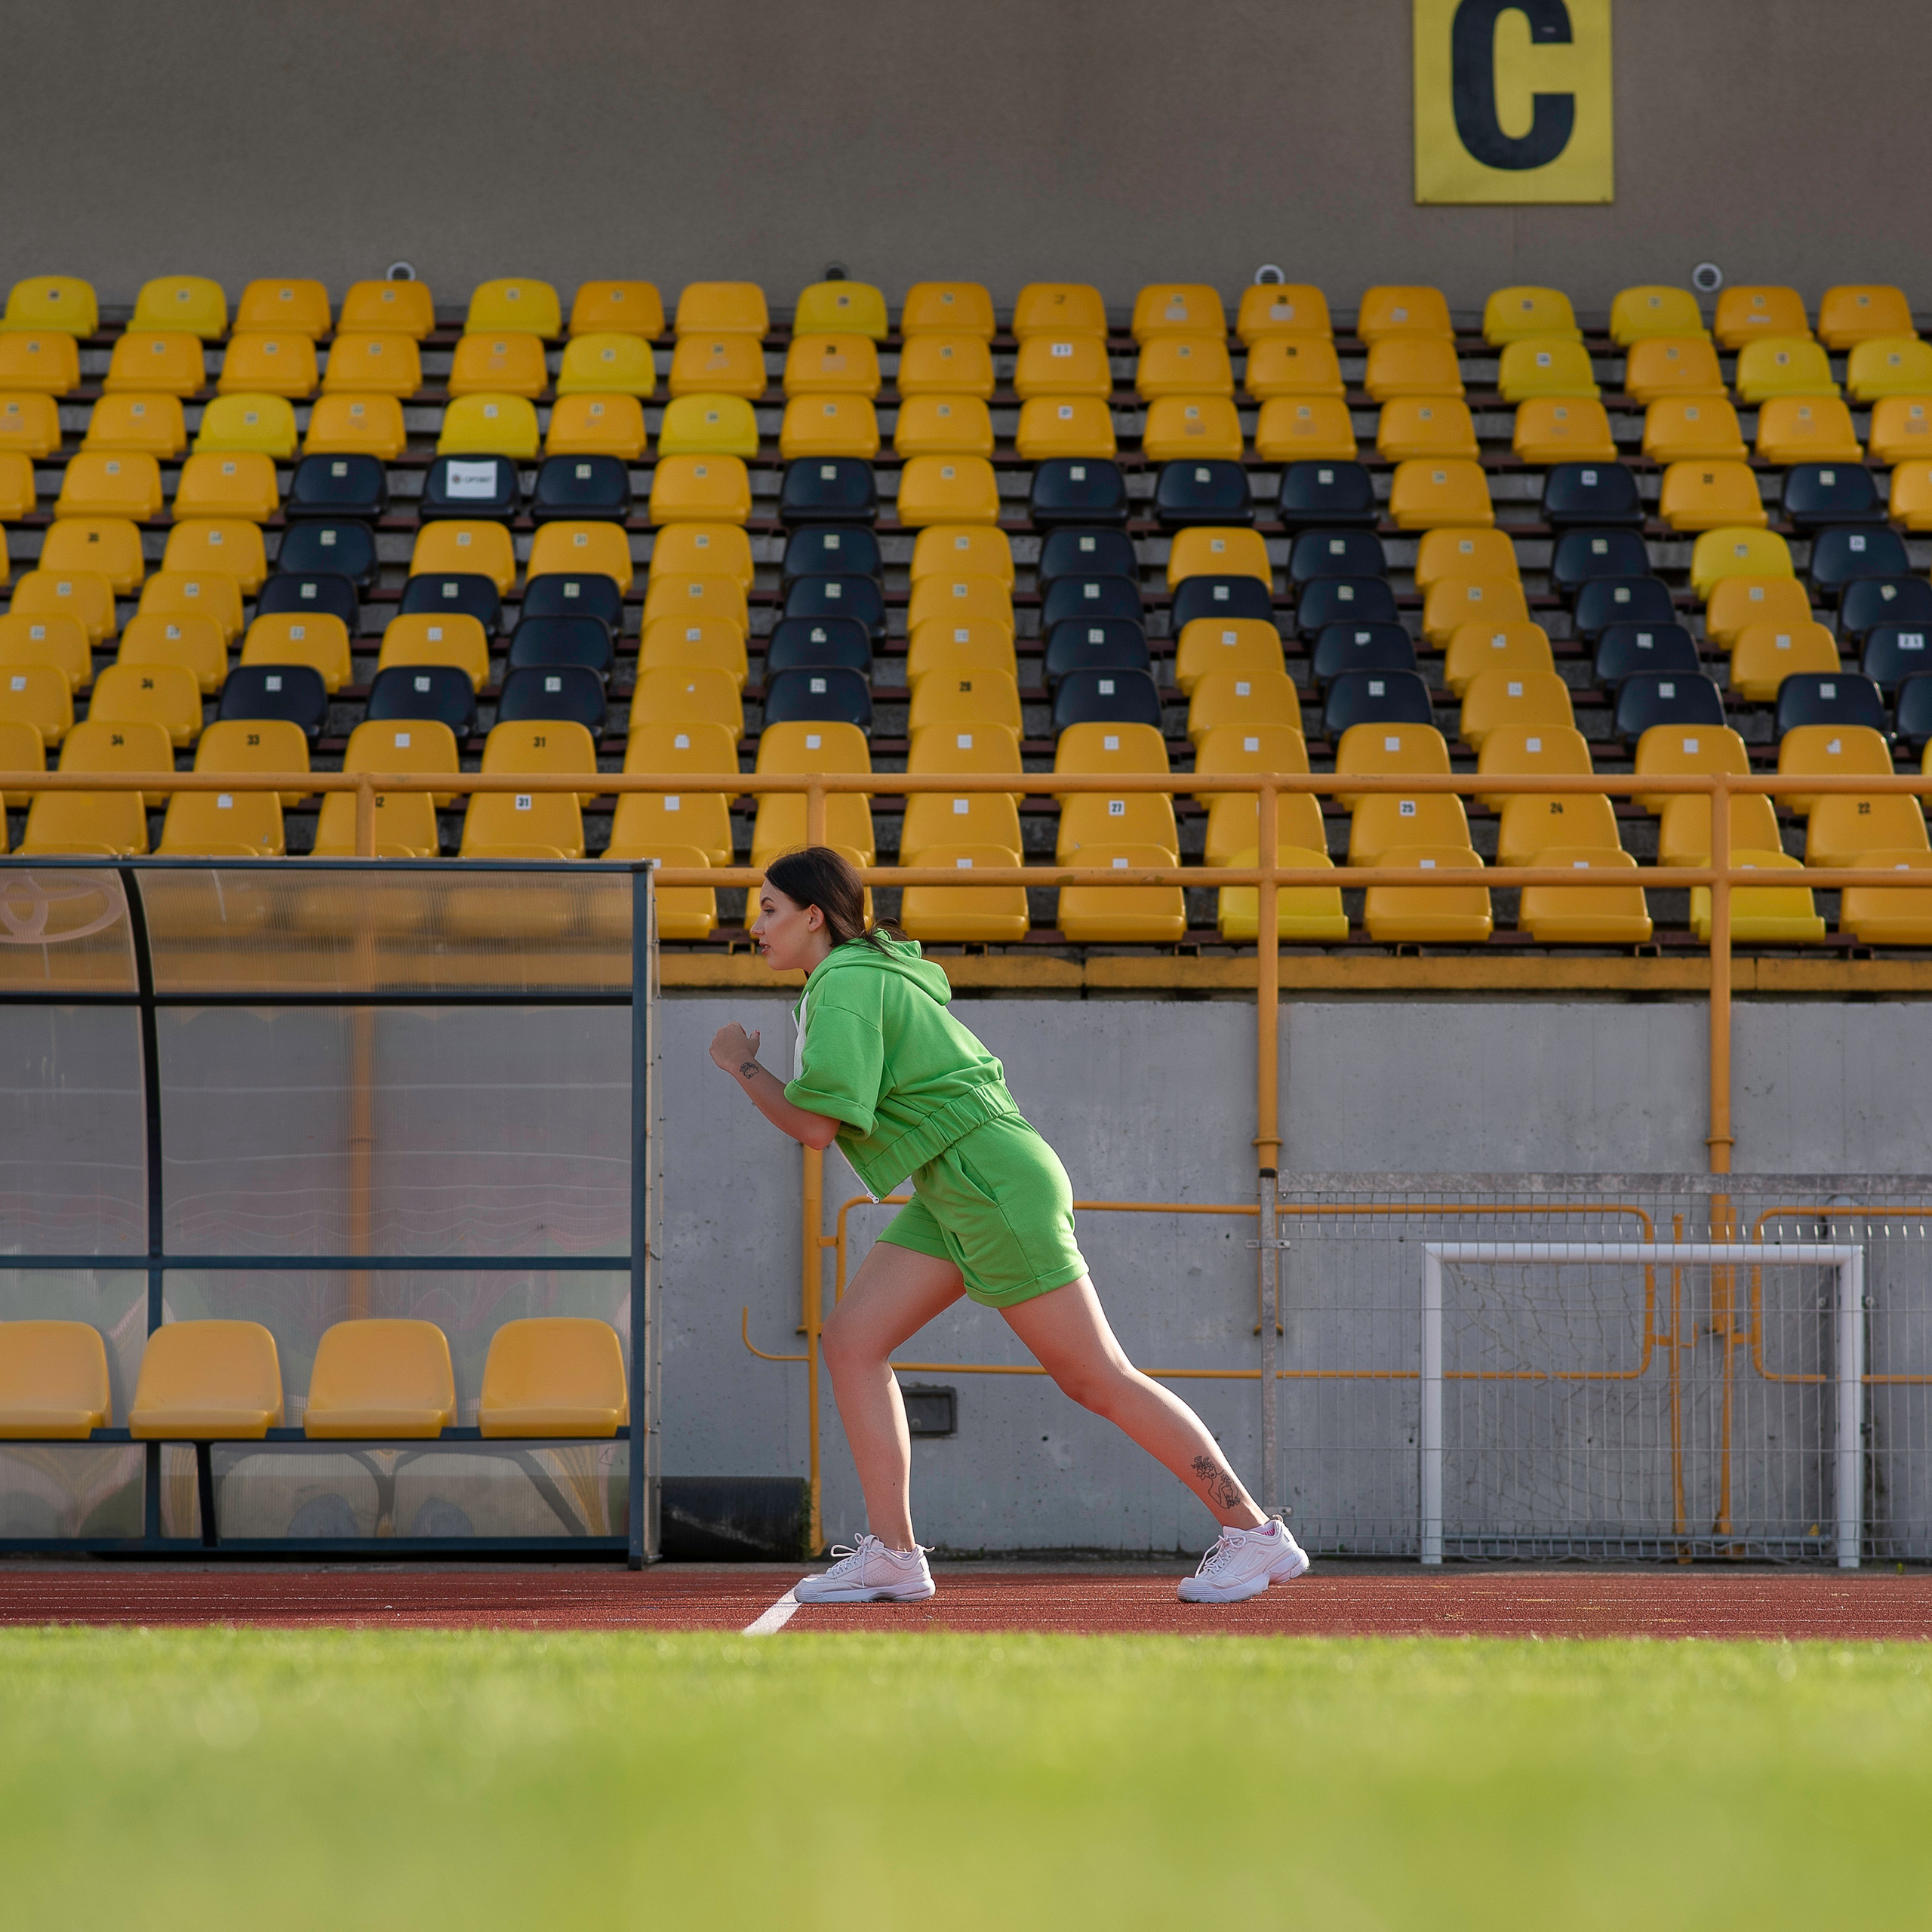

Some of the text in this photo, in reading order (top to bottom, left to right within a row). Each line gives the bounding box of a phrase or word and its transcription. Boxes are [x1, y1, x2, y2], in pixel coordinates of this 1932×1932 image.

[1451, 0, 1575, 171] C
[112, 734, 124, 746] 34
[248, 734, 260, 746] 33
[534, 736, 546, 747] 31
[518, 797, 529, 808] 31
[1112, 803, 1122, 813] 27
[1550, 802, 1563, 814] 24
[1858, 802, 1871, 814] 22
